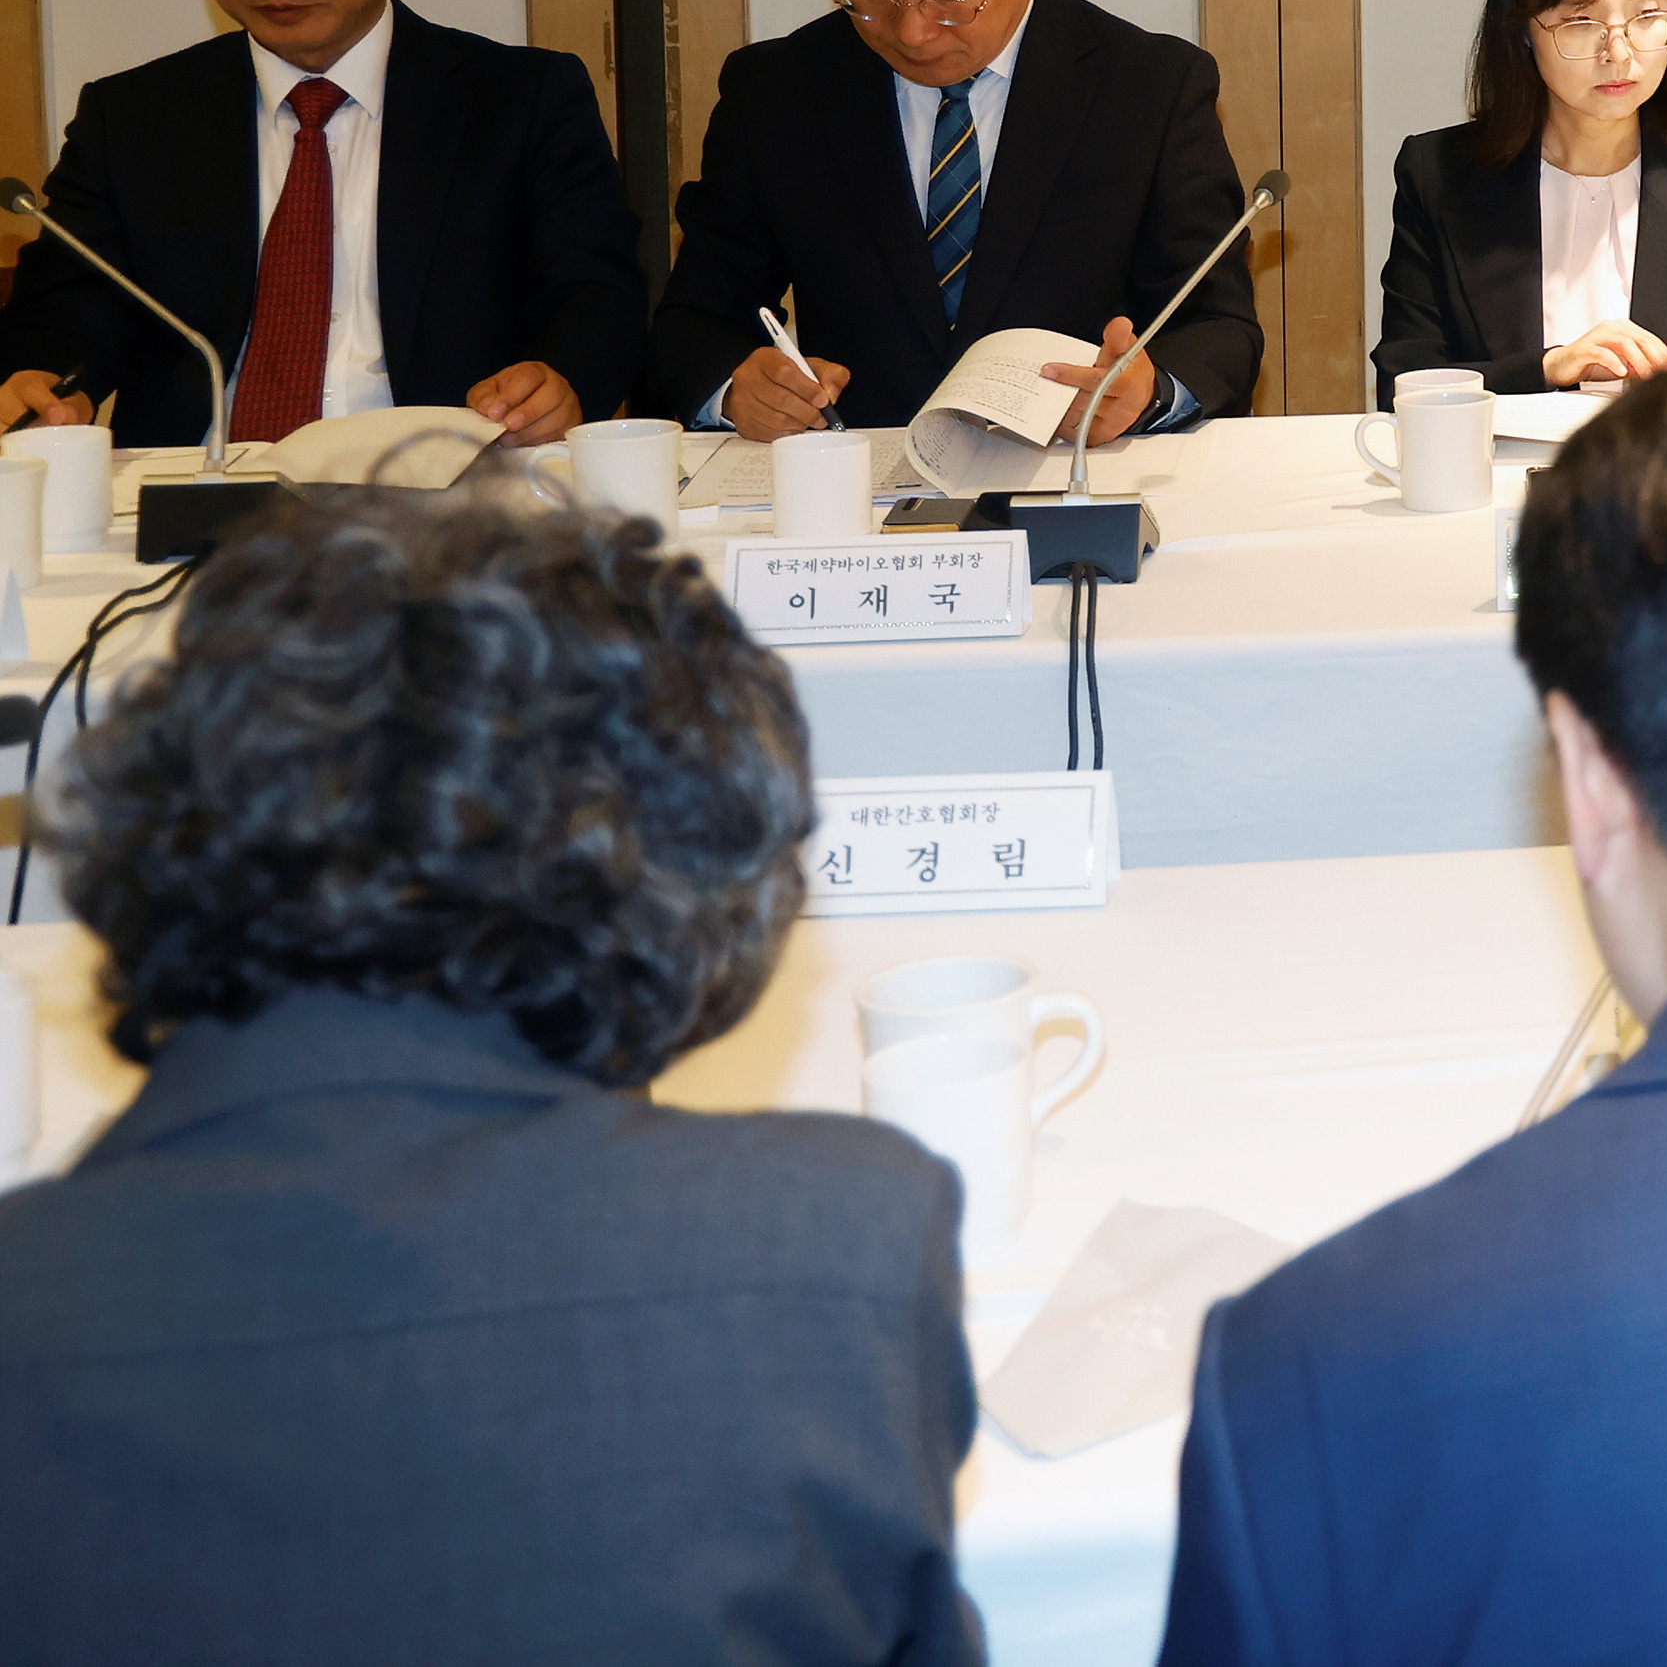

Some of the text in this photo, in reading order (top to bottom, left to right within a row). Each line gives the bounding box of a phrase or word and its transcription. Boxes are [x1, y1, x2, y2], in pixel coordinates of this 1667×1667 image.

[766, 551, 984, 576] 한국제약바이오협회 부회장
[850, 801, 1001, 827] 대한간호협회장
